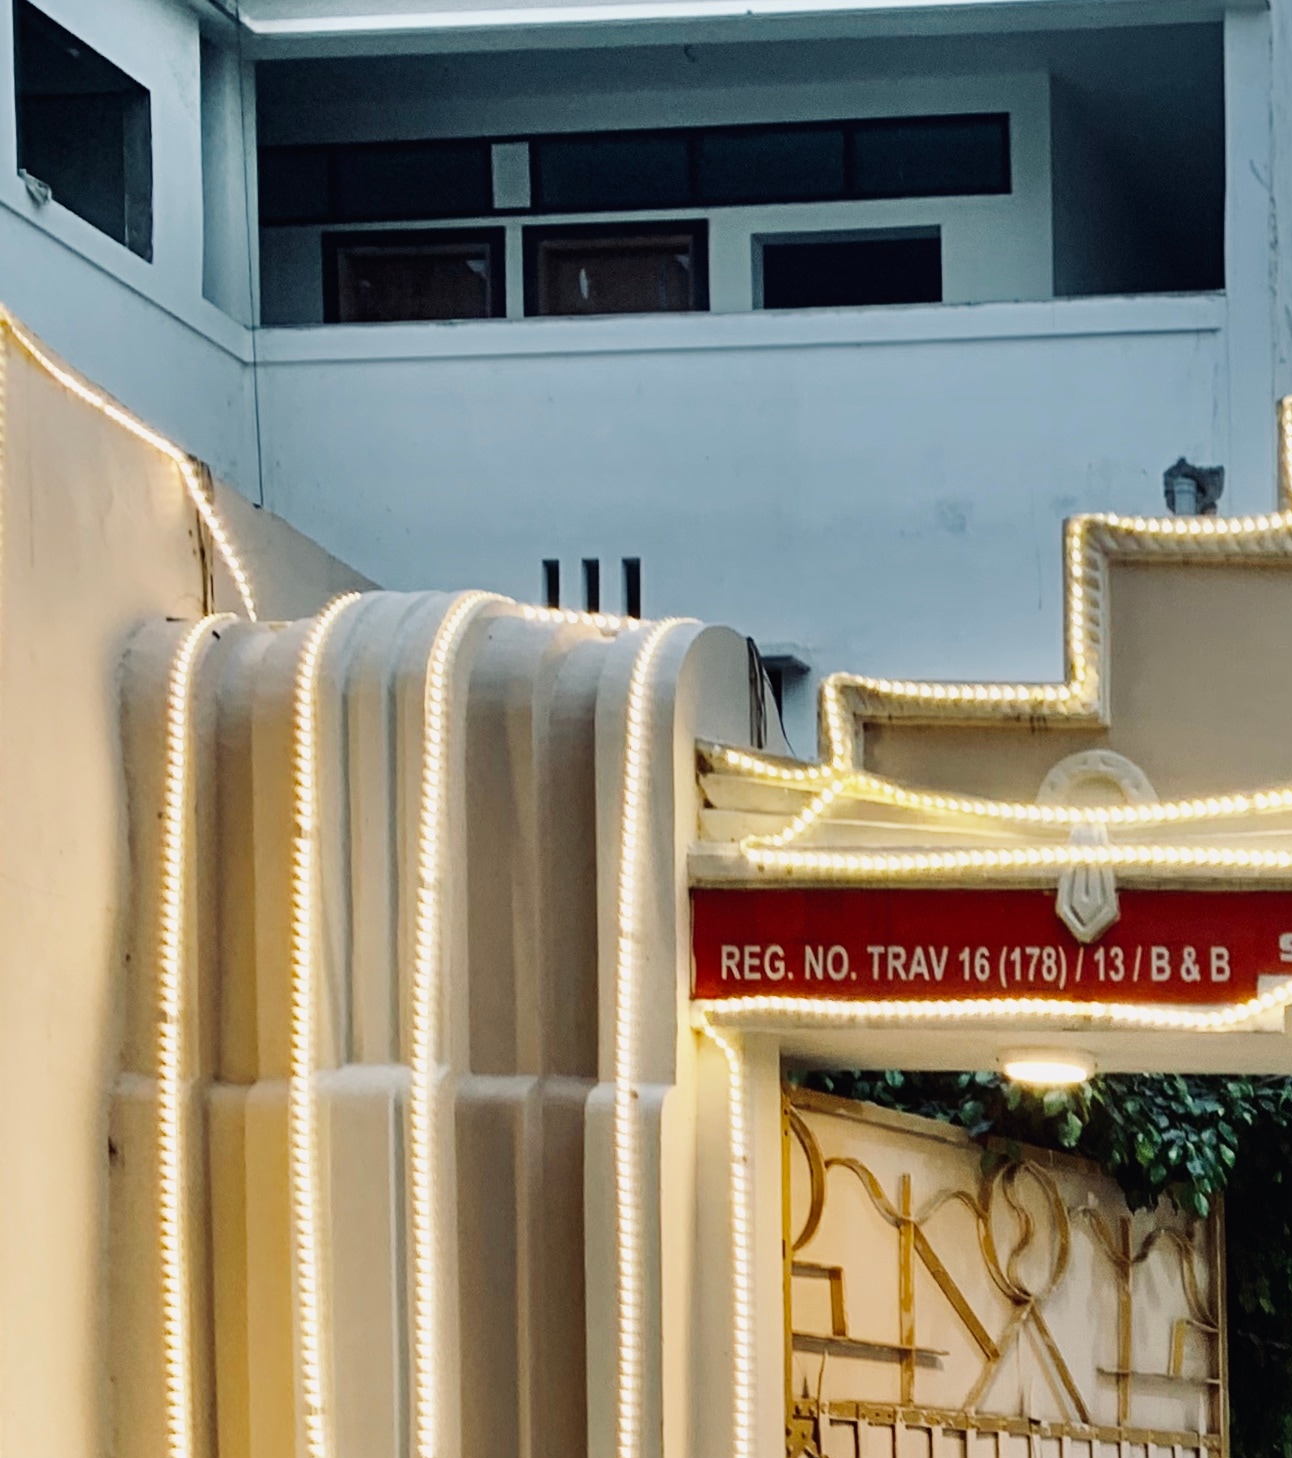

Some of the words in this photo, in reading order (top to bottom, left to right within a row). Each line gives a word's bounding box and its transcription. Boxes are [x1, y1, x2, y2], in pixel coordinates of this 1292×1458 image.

[722, 946, 792, 979] REG.
[806, 946, 855, 979] NO.
[868, 947, 947, 980] TRAV
[960, 948, 989, 980] 16
[1000, 947, 1066, 987] (178)
[1095, 948, 1124, 981] 13
[1152, 947, 1170, 980] B
[1181, 947, 1200, 981] &
[1212, 948, 1229, 981] B
